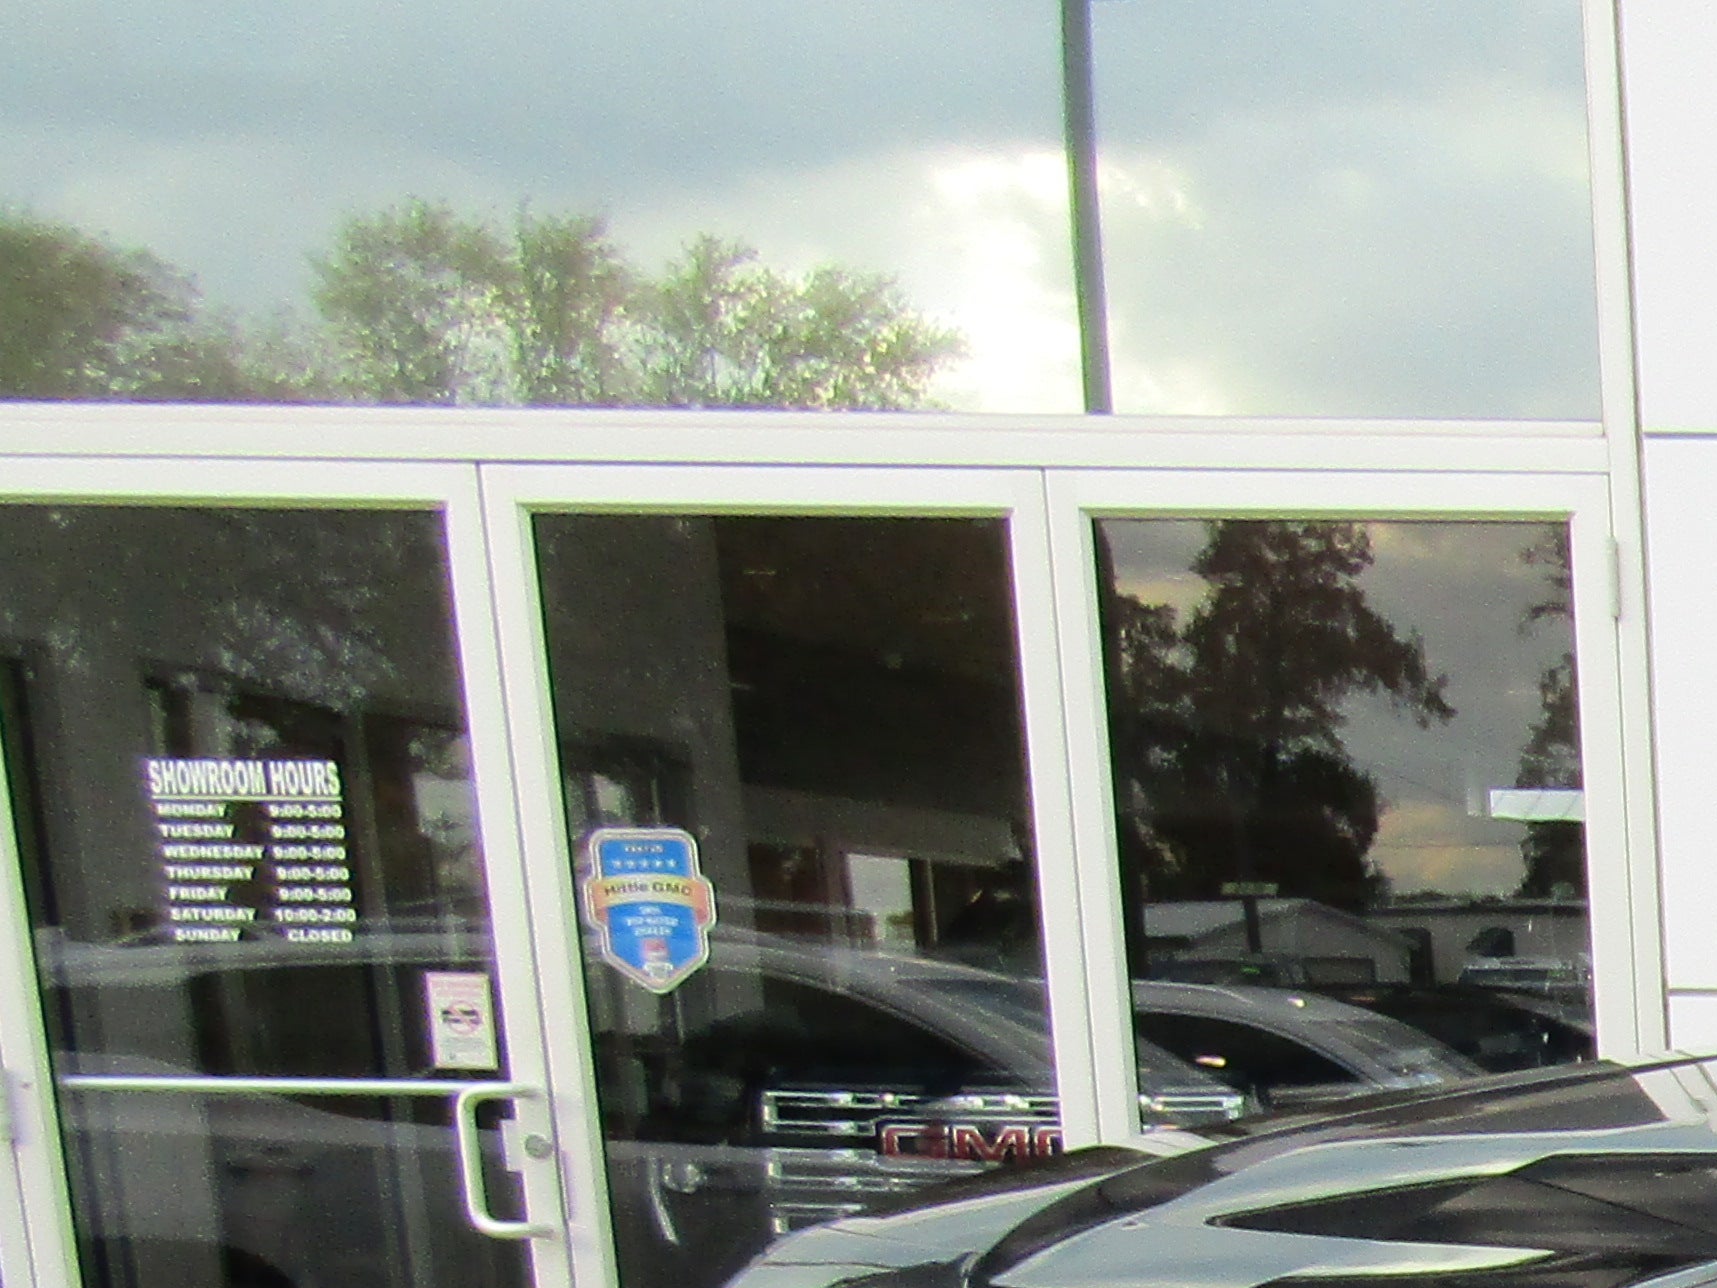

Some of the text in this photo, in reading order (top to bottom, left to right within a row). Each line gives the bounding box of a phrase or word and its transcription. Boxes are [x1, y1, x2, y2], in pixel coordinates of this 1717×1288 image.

[149, 760, 341, 796] SHOWROOM HOURS
[155, 803, 227, 818] MONDAY
[158, 823, 235, 839] TUESDAY
[162, 844, 265, 860] WEDNESDAY
[164, 865, 255, 881] THURSDAY
[168, 886, 229, 901] FRIDAY
[170, 907, 257, 922] SATURDAY
[173, 927, 354, 943] SUNDAY CLOSED
